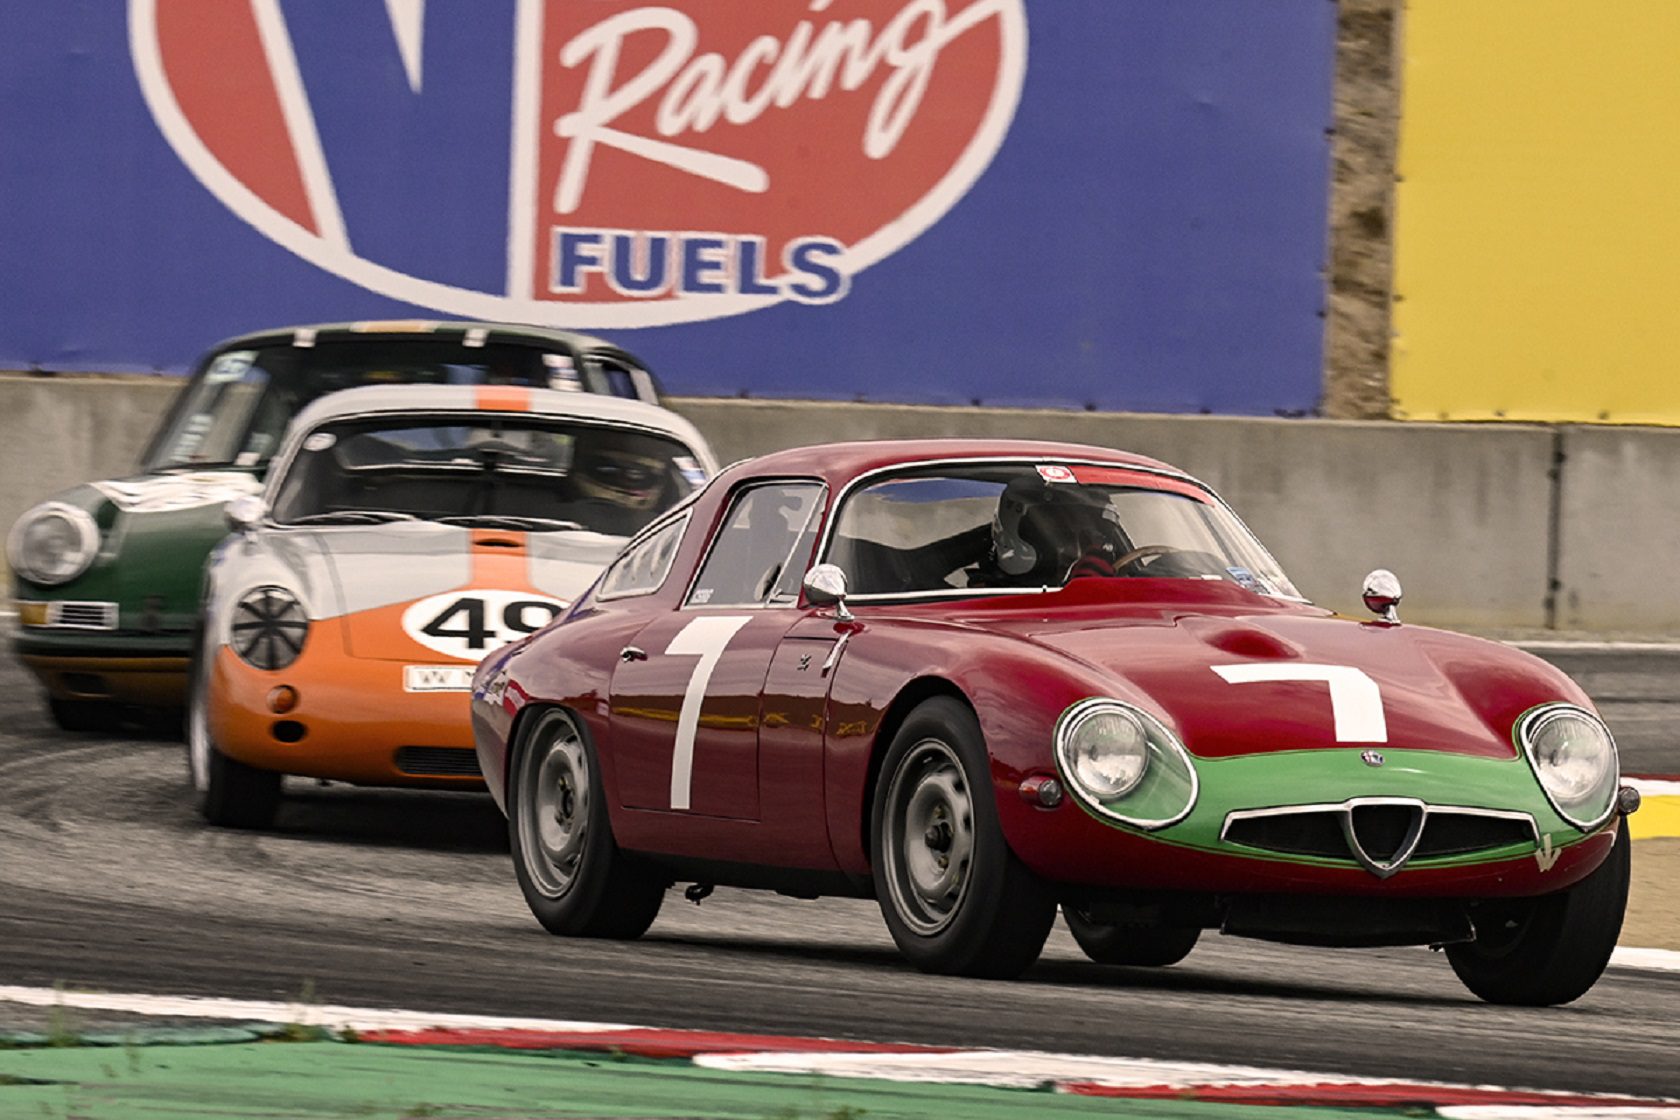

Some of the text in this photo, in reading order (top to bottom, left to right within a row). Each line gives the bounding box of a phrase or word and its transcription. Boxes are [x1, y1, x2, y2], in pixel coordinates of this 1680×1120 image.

[554, 0, 1001, 214] Racing
[550, 226, 850, 304] FUELS
[664, 615, 754, 810] 7
[1209, 662, 1388, 743] 7
